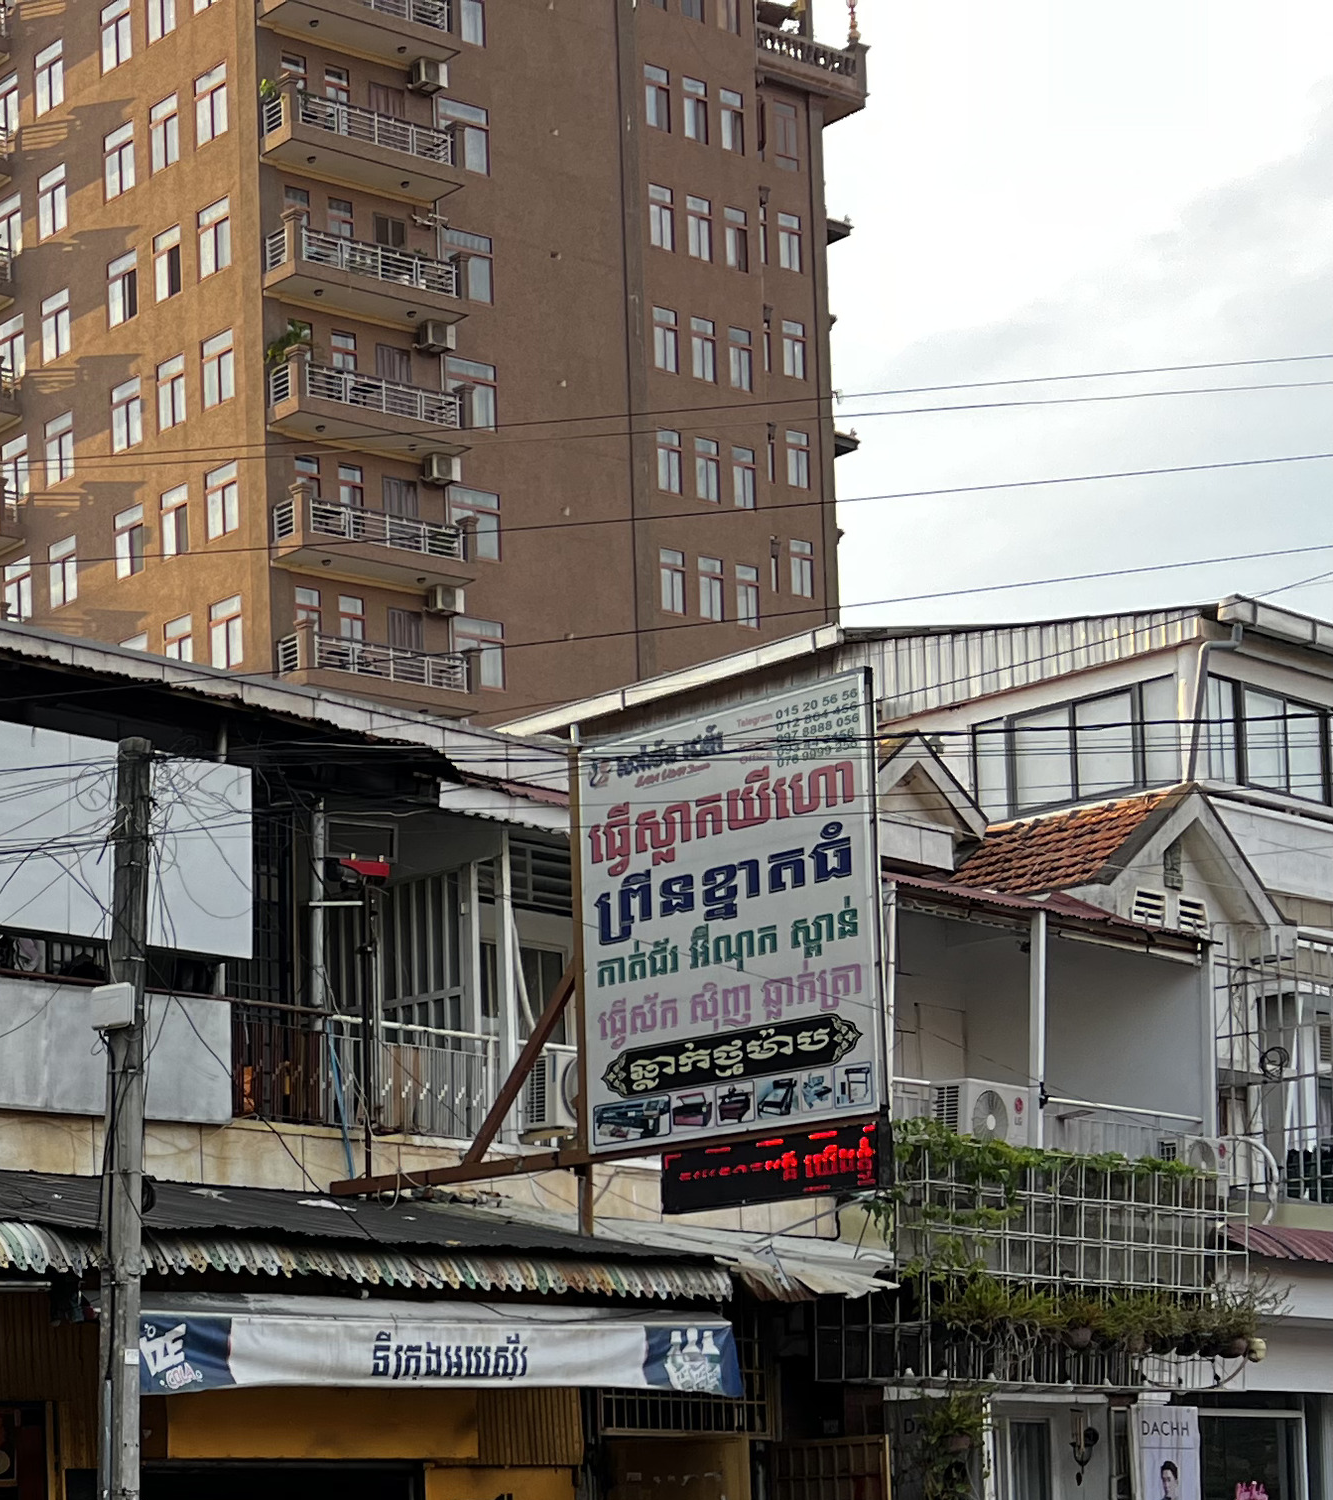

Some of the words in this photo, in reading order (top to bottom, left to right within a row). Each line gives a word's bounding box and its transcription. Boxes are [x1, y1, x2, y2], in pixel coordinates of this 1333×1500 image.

[775, 704, 799, 720] 015
[802, 699, 818, 713] 20
[821, 693, 838, 707] 56
[841, 687, 859, 701] 56
[1141, 1420, 1191, 1437] DACHH
